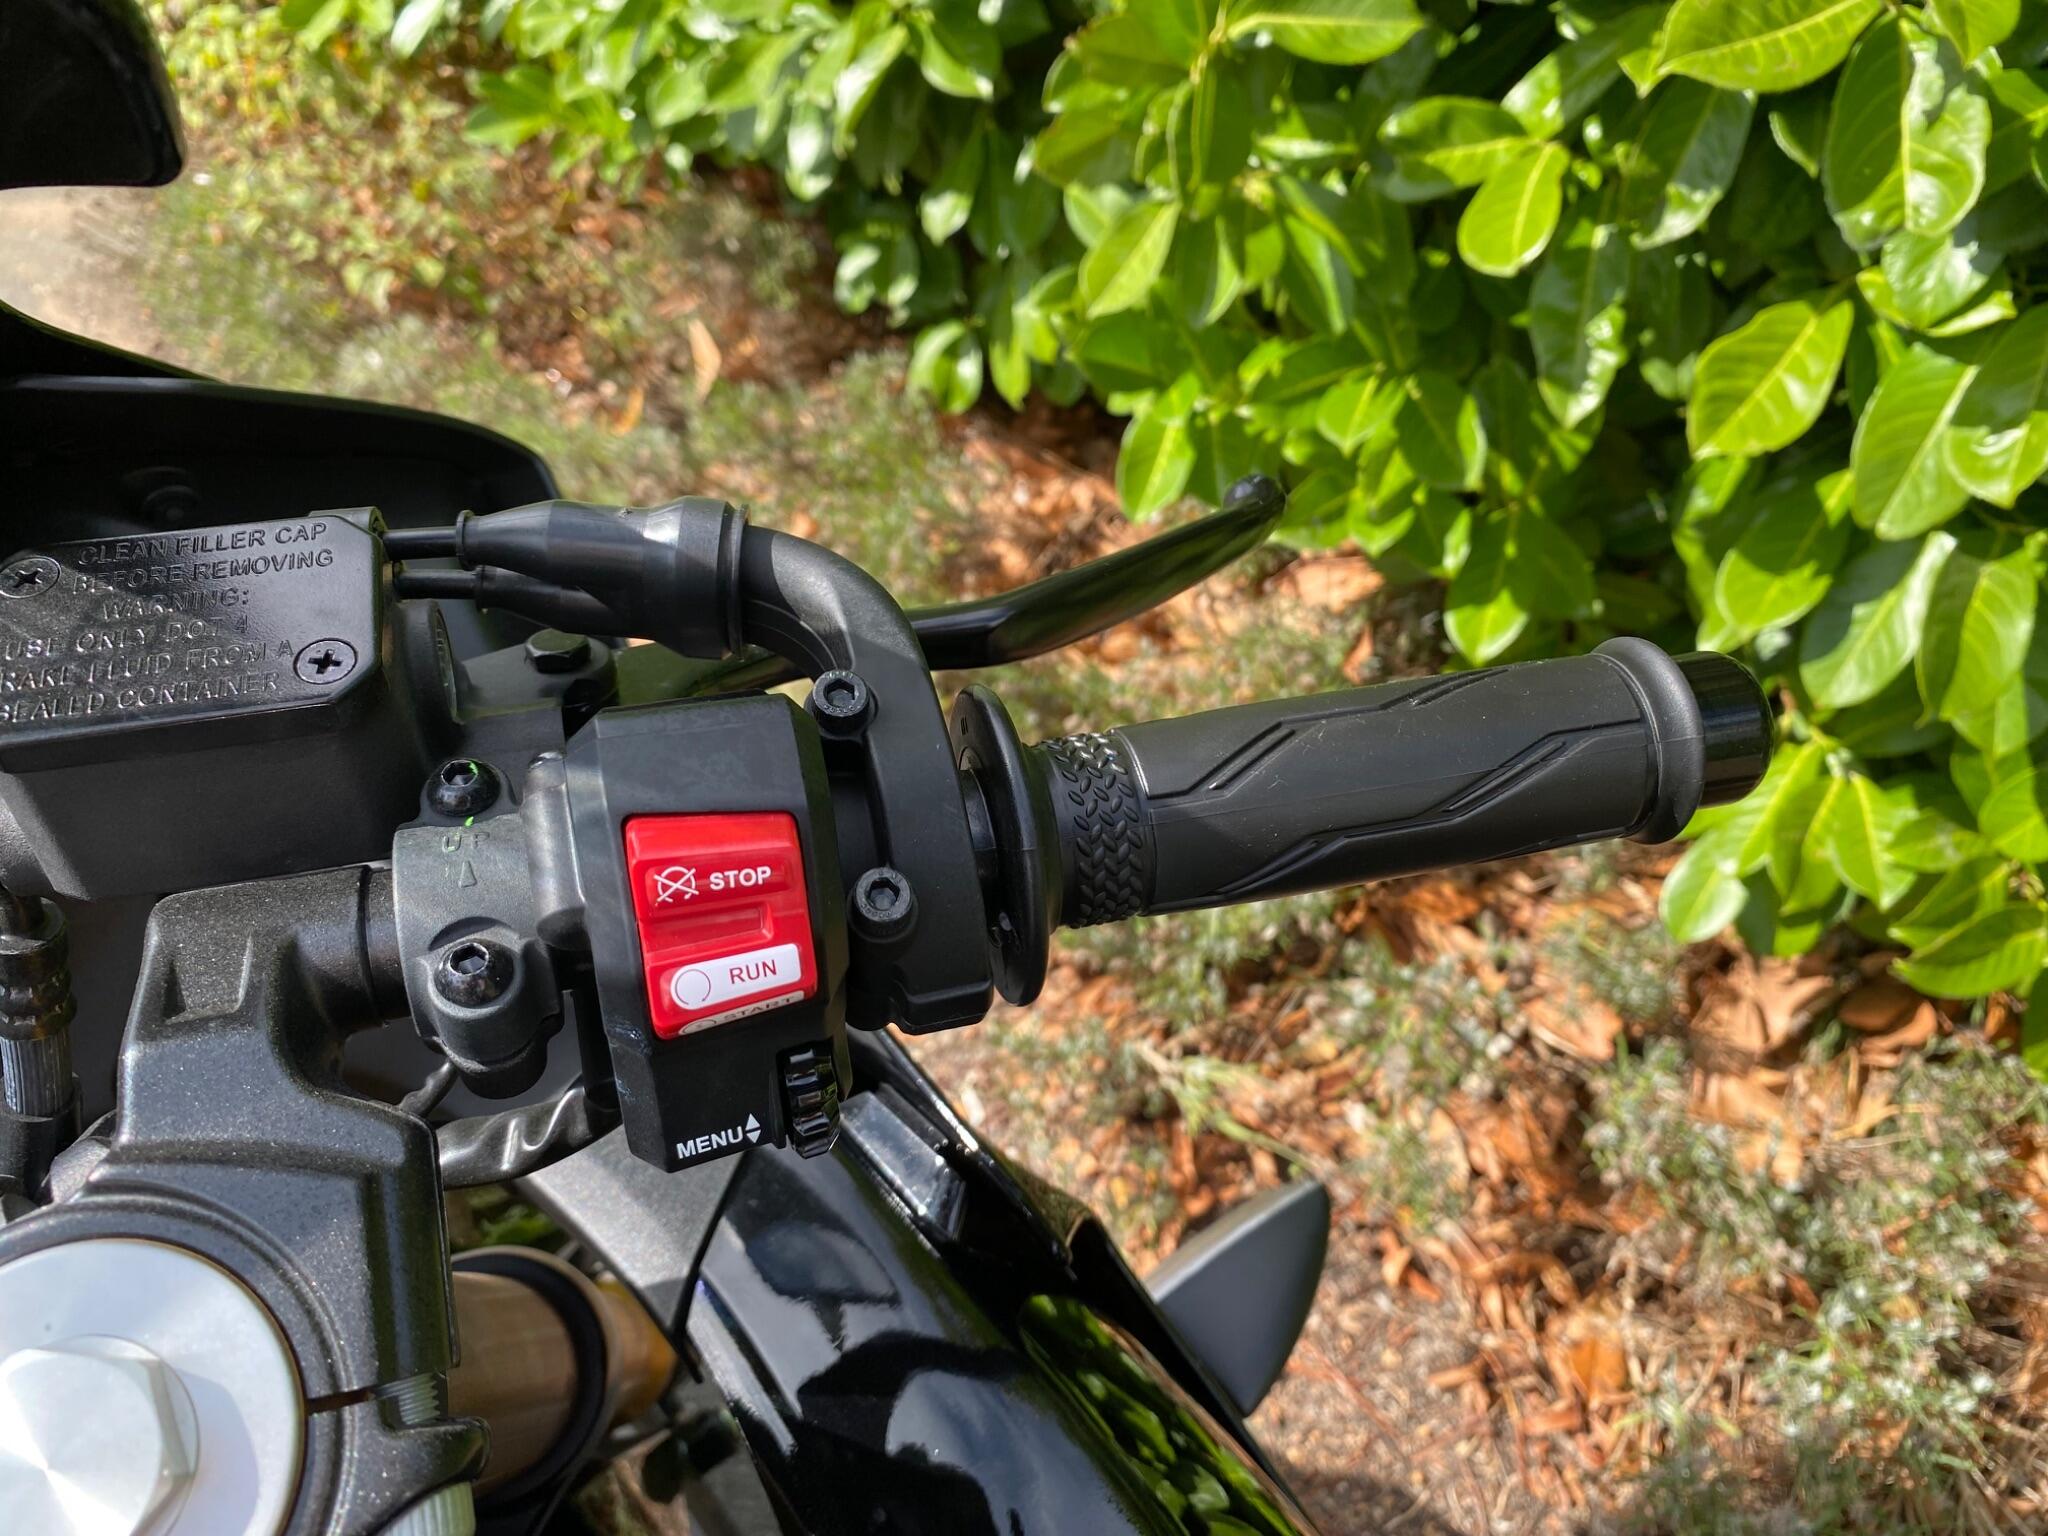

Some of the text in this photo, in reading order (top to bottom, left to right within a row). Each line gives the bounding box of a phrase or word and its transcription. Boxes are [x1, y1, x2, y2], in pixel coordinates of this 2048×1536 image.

[78, 522, 327, 566] CLEAN FILLER CAP
[72, 548, 334, 595] BEFORE REMOVING
[166, 616, 223, 642] DOT
[235, 614, 249, 634] 4
[185, 642, 267, 673] FROM
[276, 639, 295, 659] A
[118, 670, 280, 709] CONTAINER
[709, 866, 773, 891] STOP
[729, 958, 778, 985] RUN
[723, 996, 795, 1021] START
[676, 1125, 744, 1160] MENU
